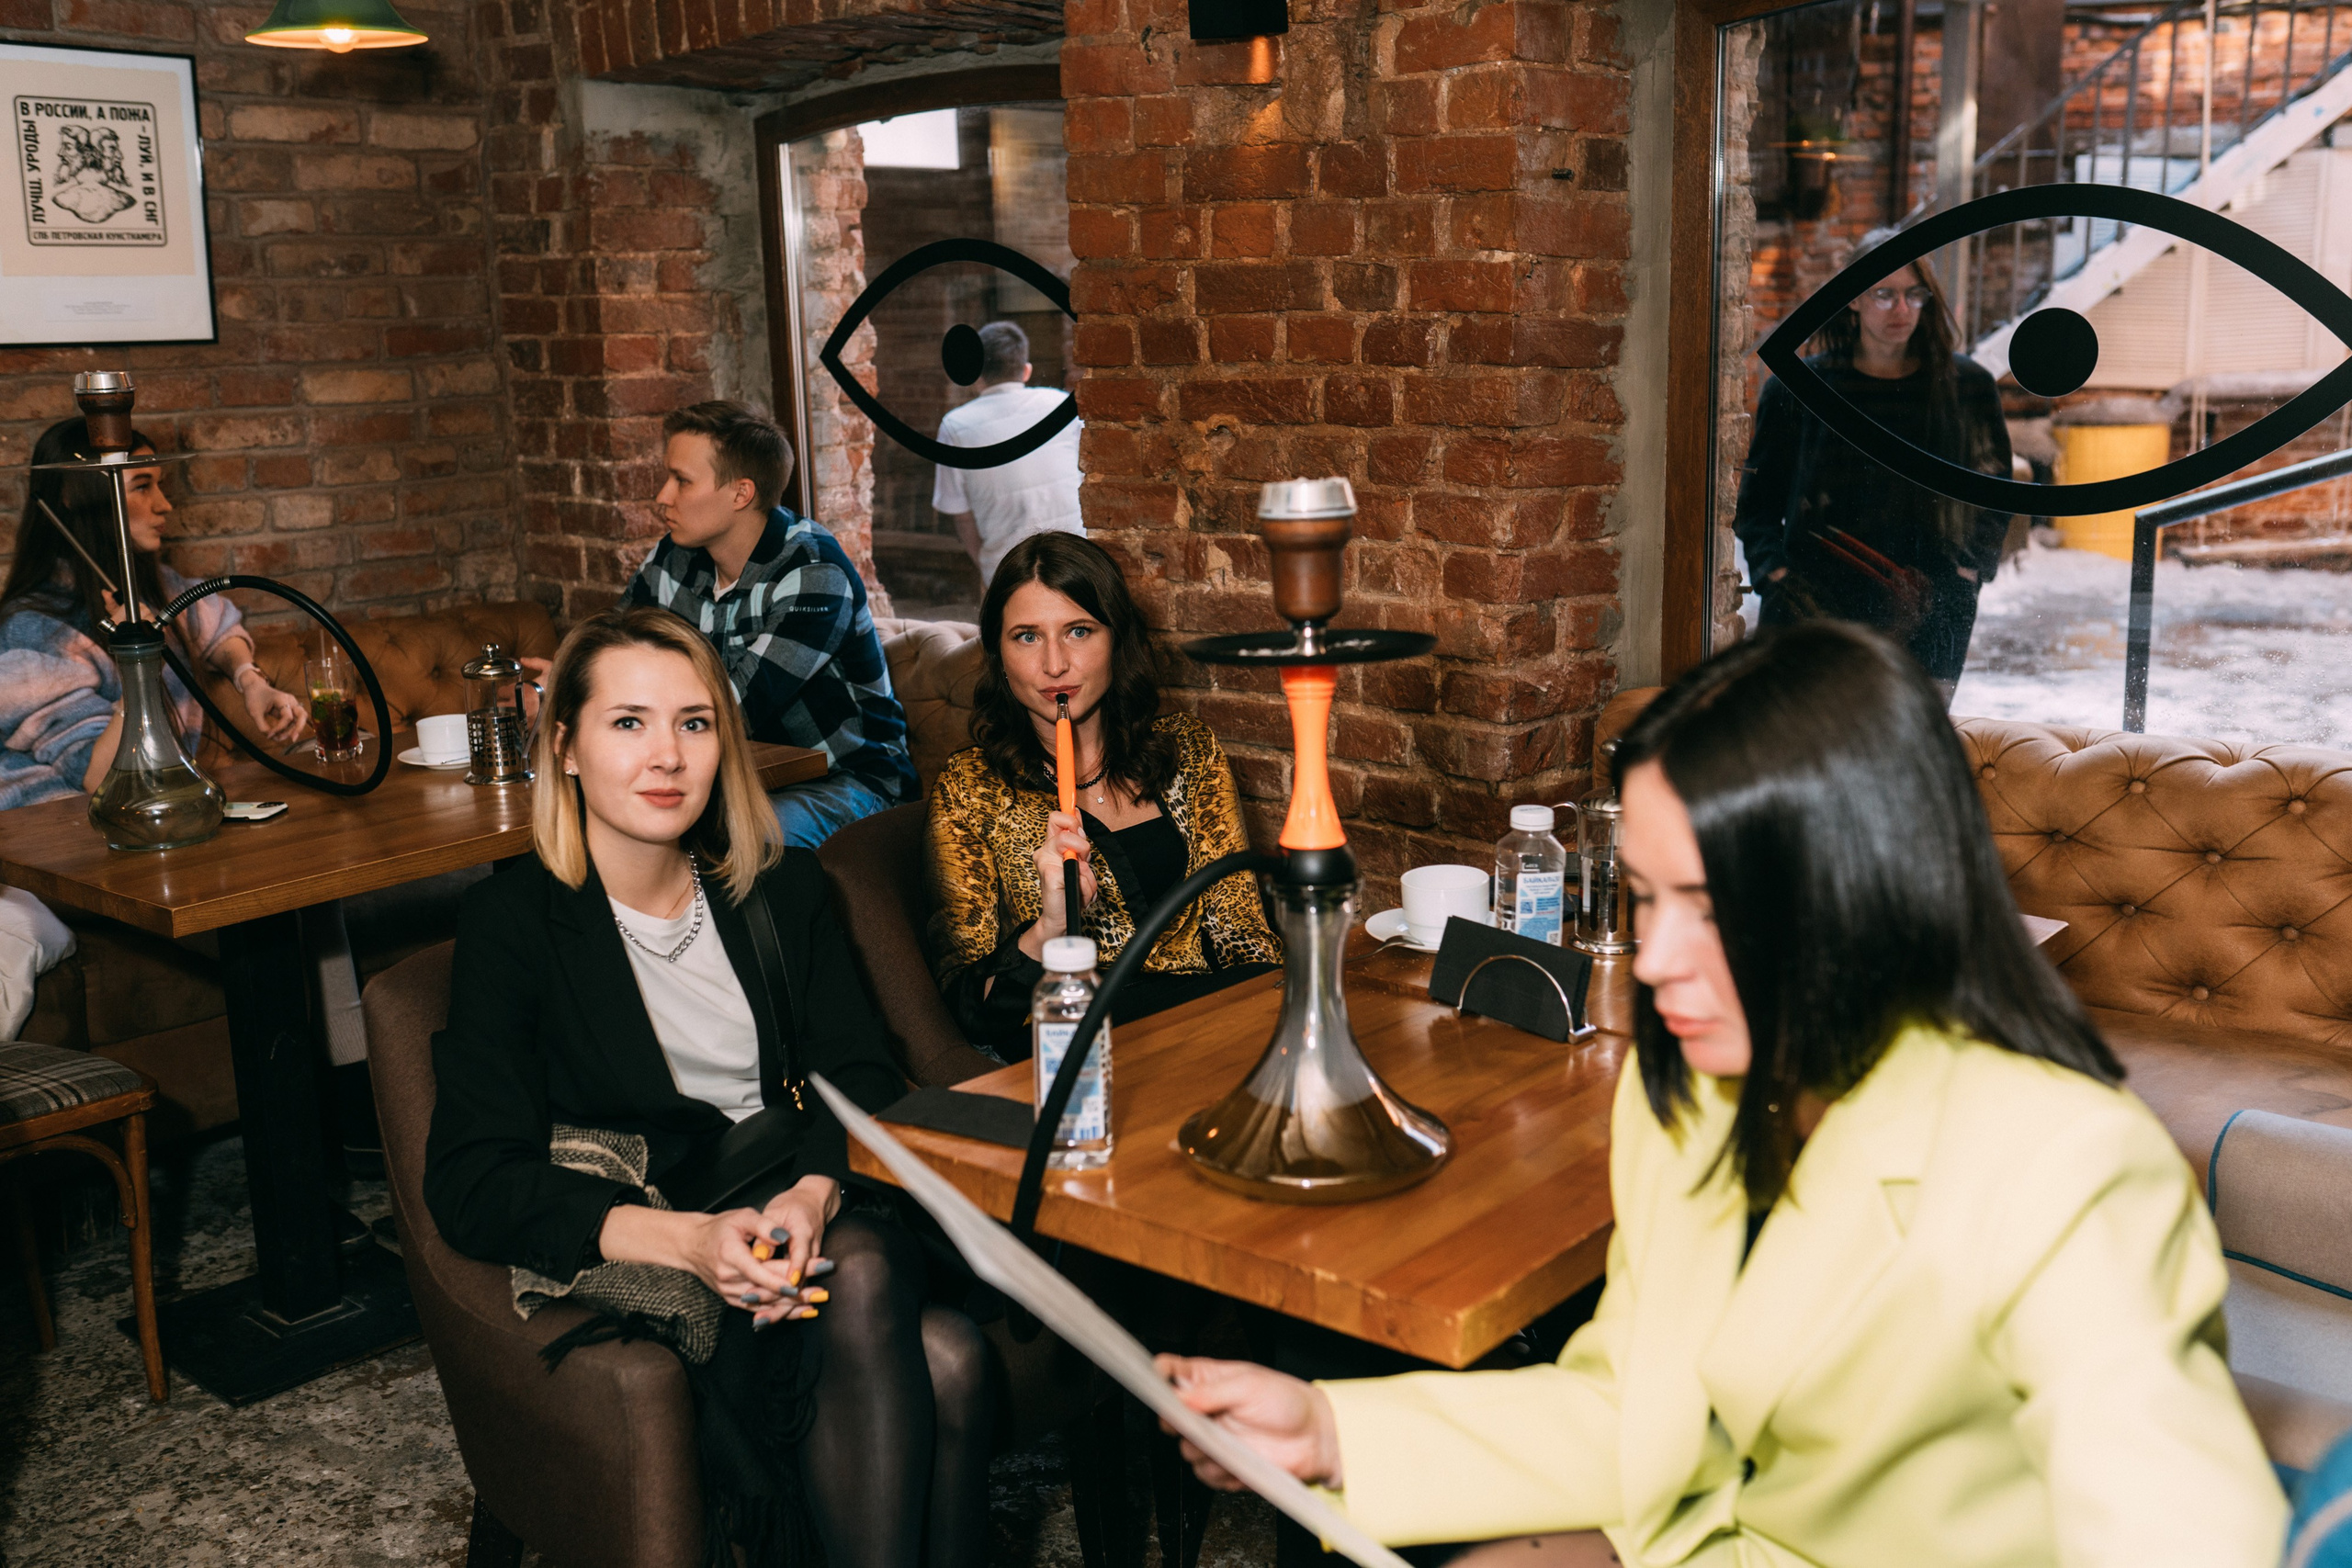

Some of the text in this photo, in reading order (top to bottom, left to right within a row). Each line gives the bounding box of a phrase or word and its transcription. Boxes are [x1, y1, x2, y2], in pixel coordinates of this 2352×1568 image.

[20, 101, 150, 122] В РОССИИ, А ПОЖА
[22, 119, 46, 224] ЛУЧШ. УРОДЫ
[141, 173, 154, 181] И
[141, 186, 156, 196] В
[143, 201, 159, 226] СНГ
[51, 231, 104, 241] ПЕТРОВСКАЯ
[106, 231, 163, 241] КУНСТКАМЕРА
